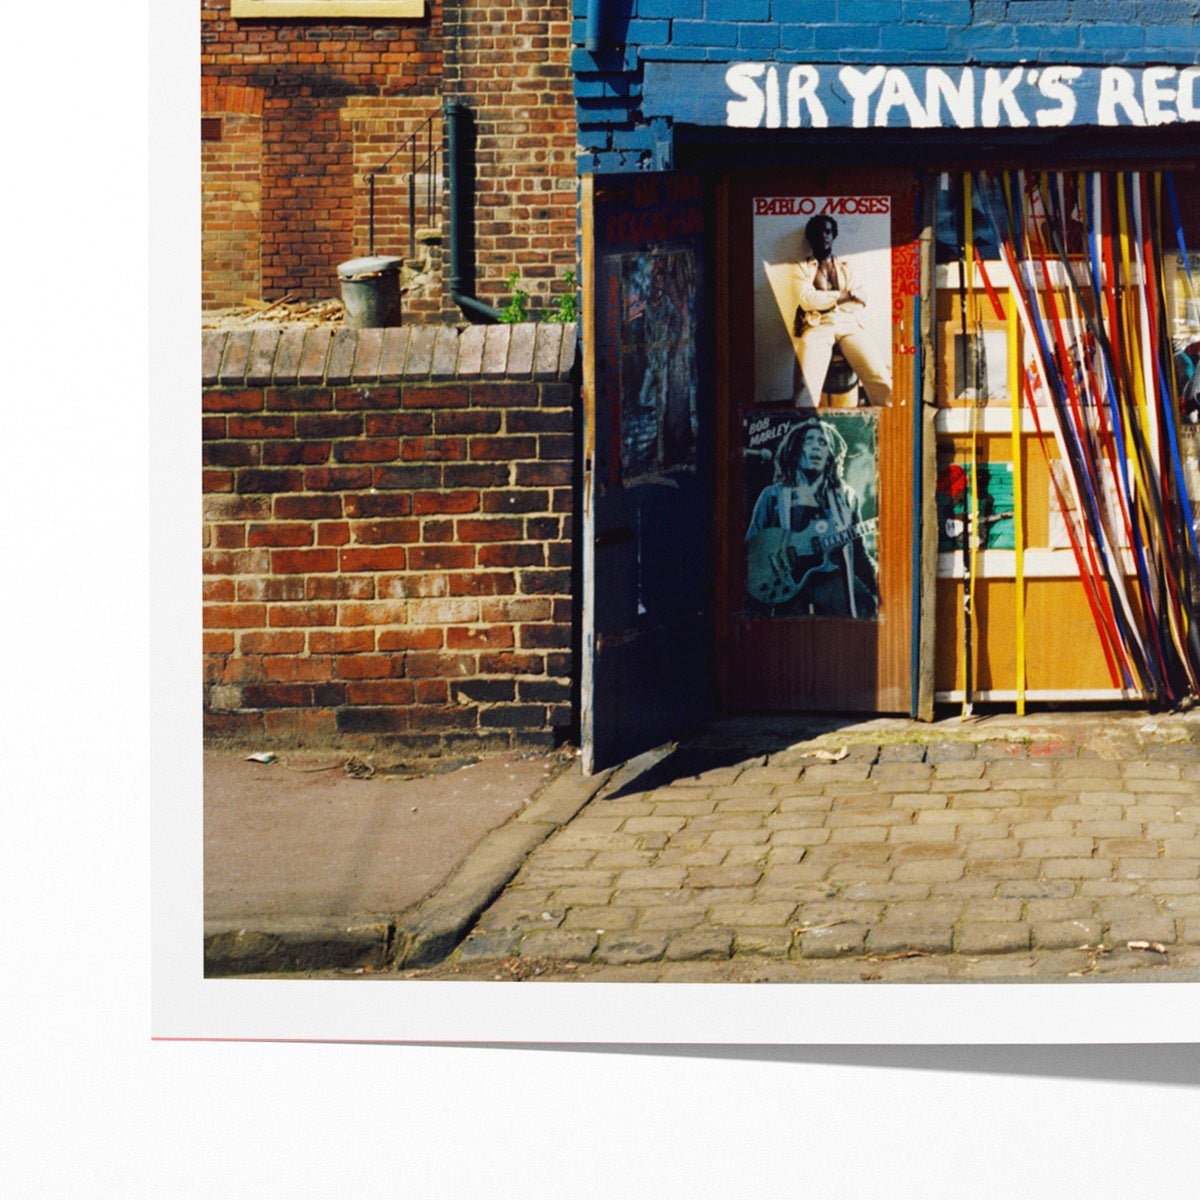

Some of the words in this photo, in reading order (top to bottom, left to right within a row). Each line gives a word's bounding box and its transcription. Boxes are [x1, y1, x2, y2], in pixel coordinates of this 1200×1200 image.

[725, 62, 829, 129] SIR
[838, 63, 1083, 129] YANK'S
[755, 198, 816, 215] PABLO
[820, 197, 889, 215] MOSES
[749, 417, 770, 435] BOB
[750, 420, 790, 447] MARLEY
